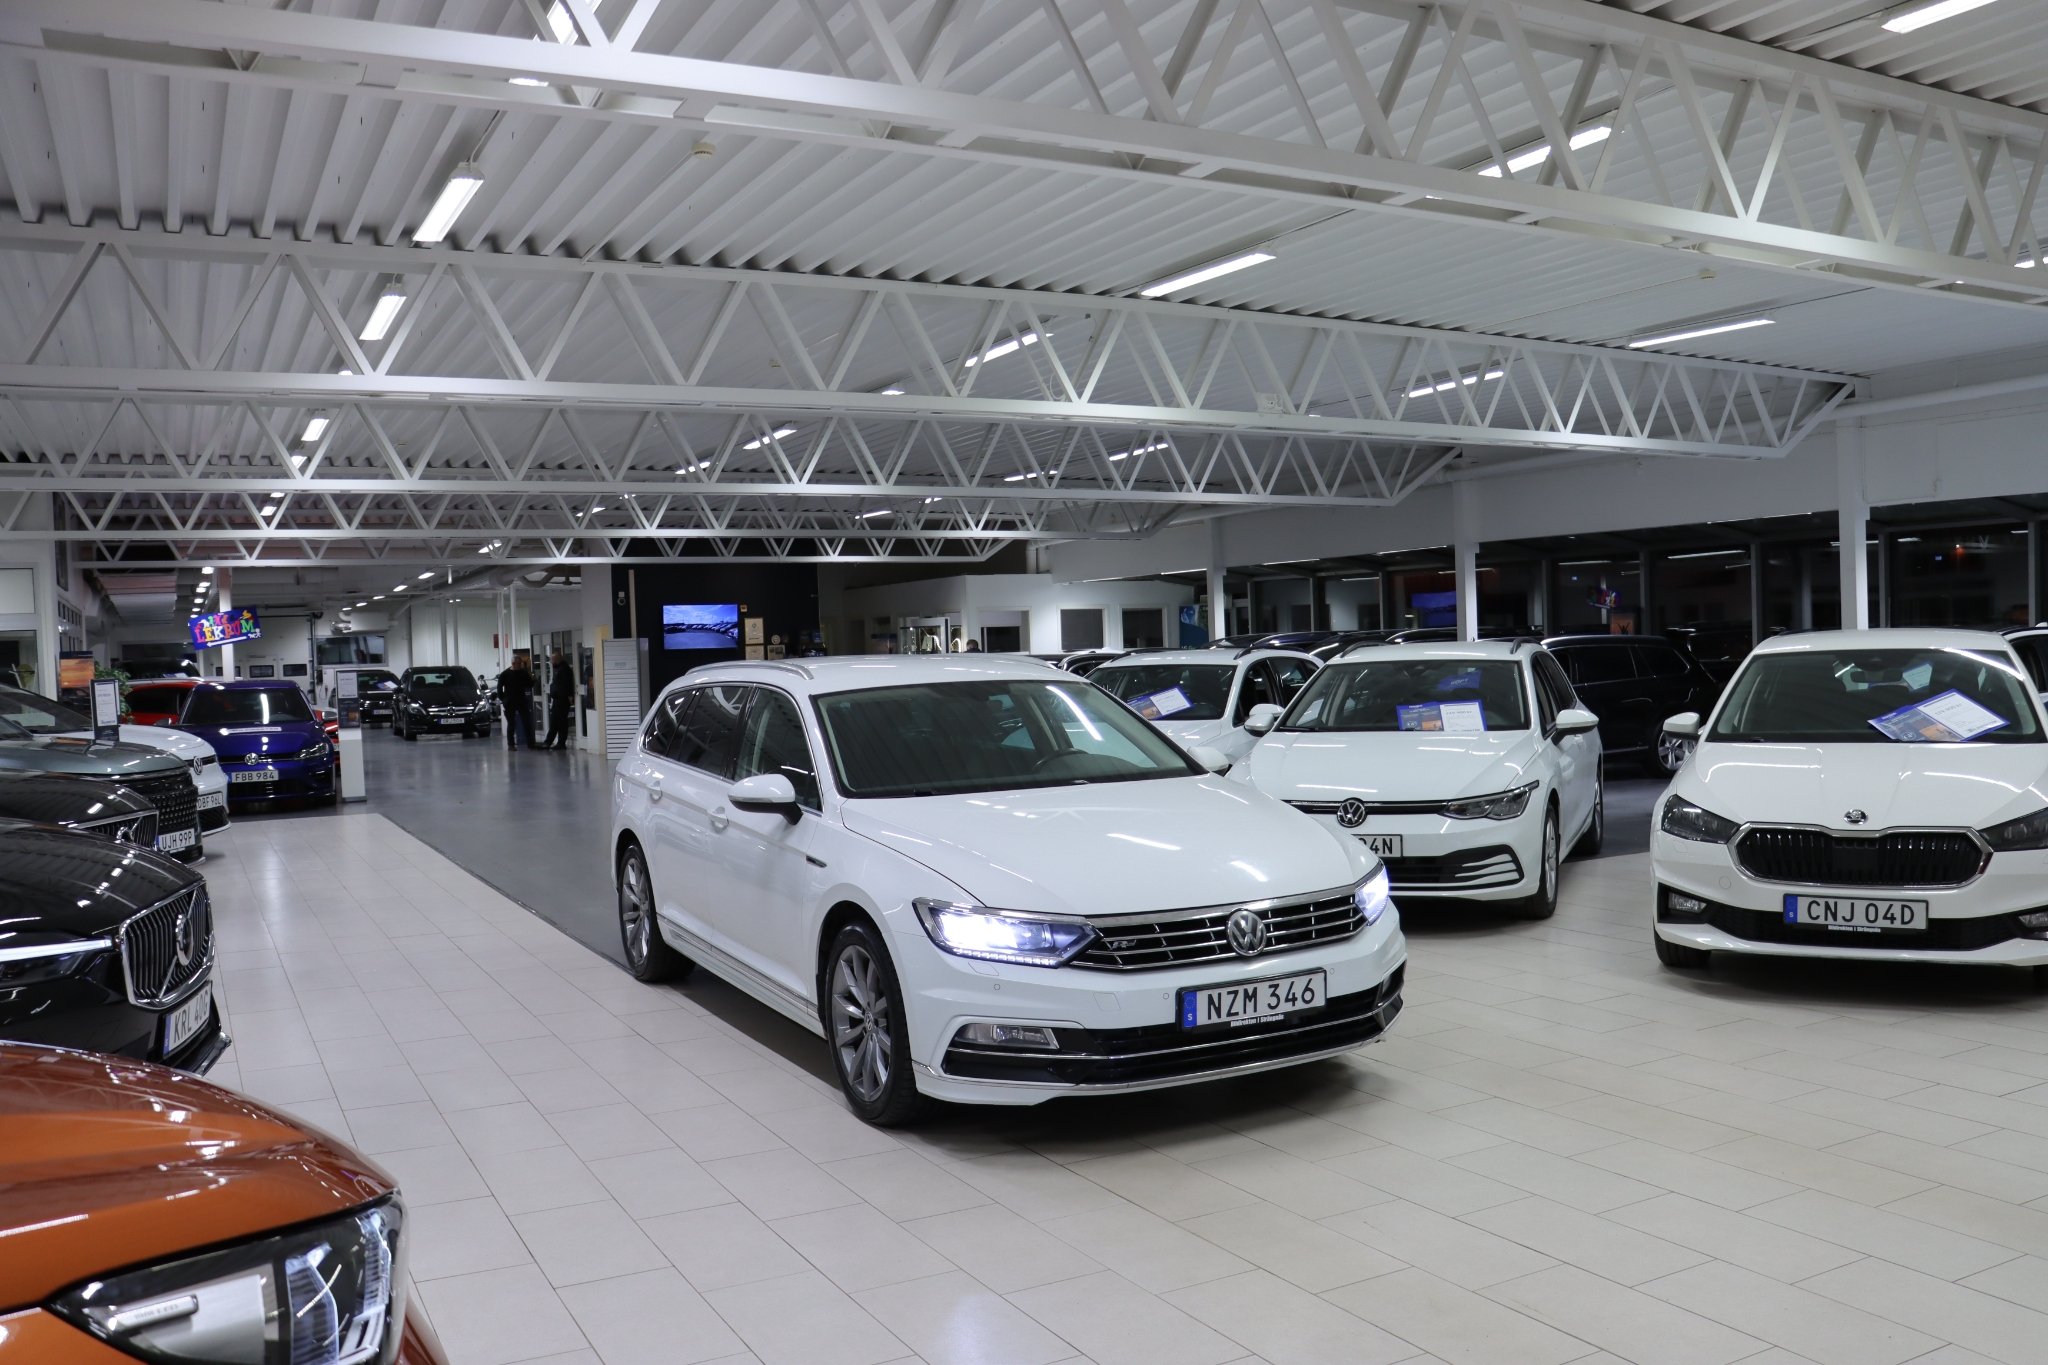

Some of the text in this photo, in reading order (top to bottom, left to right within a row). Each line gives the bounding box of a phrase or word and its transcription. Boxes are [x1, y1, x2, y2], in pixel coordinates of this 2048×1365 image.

[194, 620, 256, 643] LEKRUM
[235, 771, 274, 781] FBB 984
[162, 834, 178, 849] UJH
[1807, 900, 1855, 922] CNJ
[1865, 903, 1914, 925] 04D
[1187, 978, 1315, 1021] S NZM 346
[173, 1005, 192, 1043] KRL
